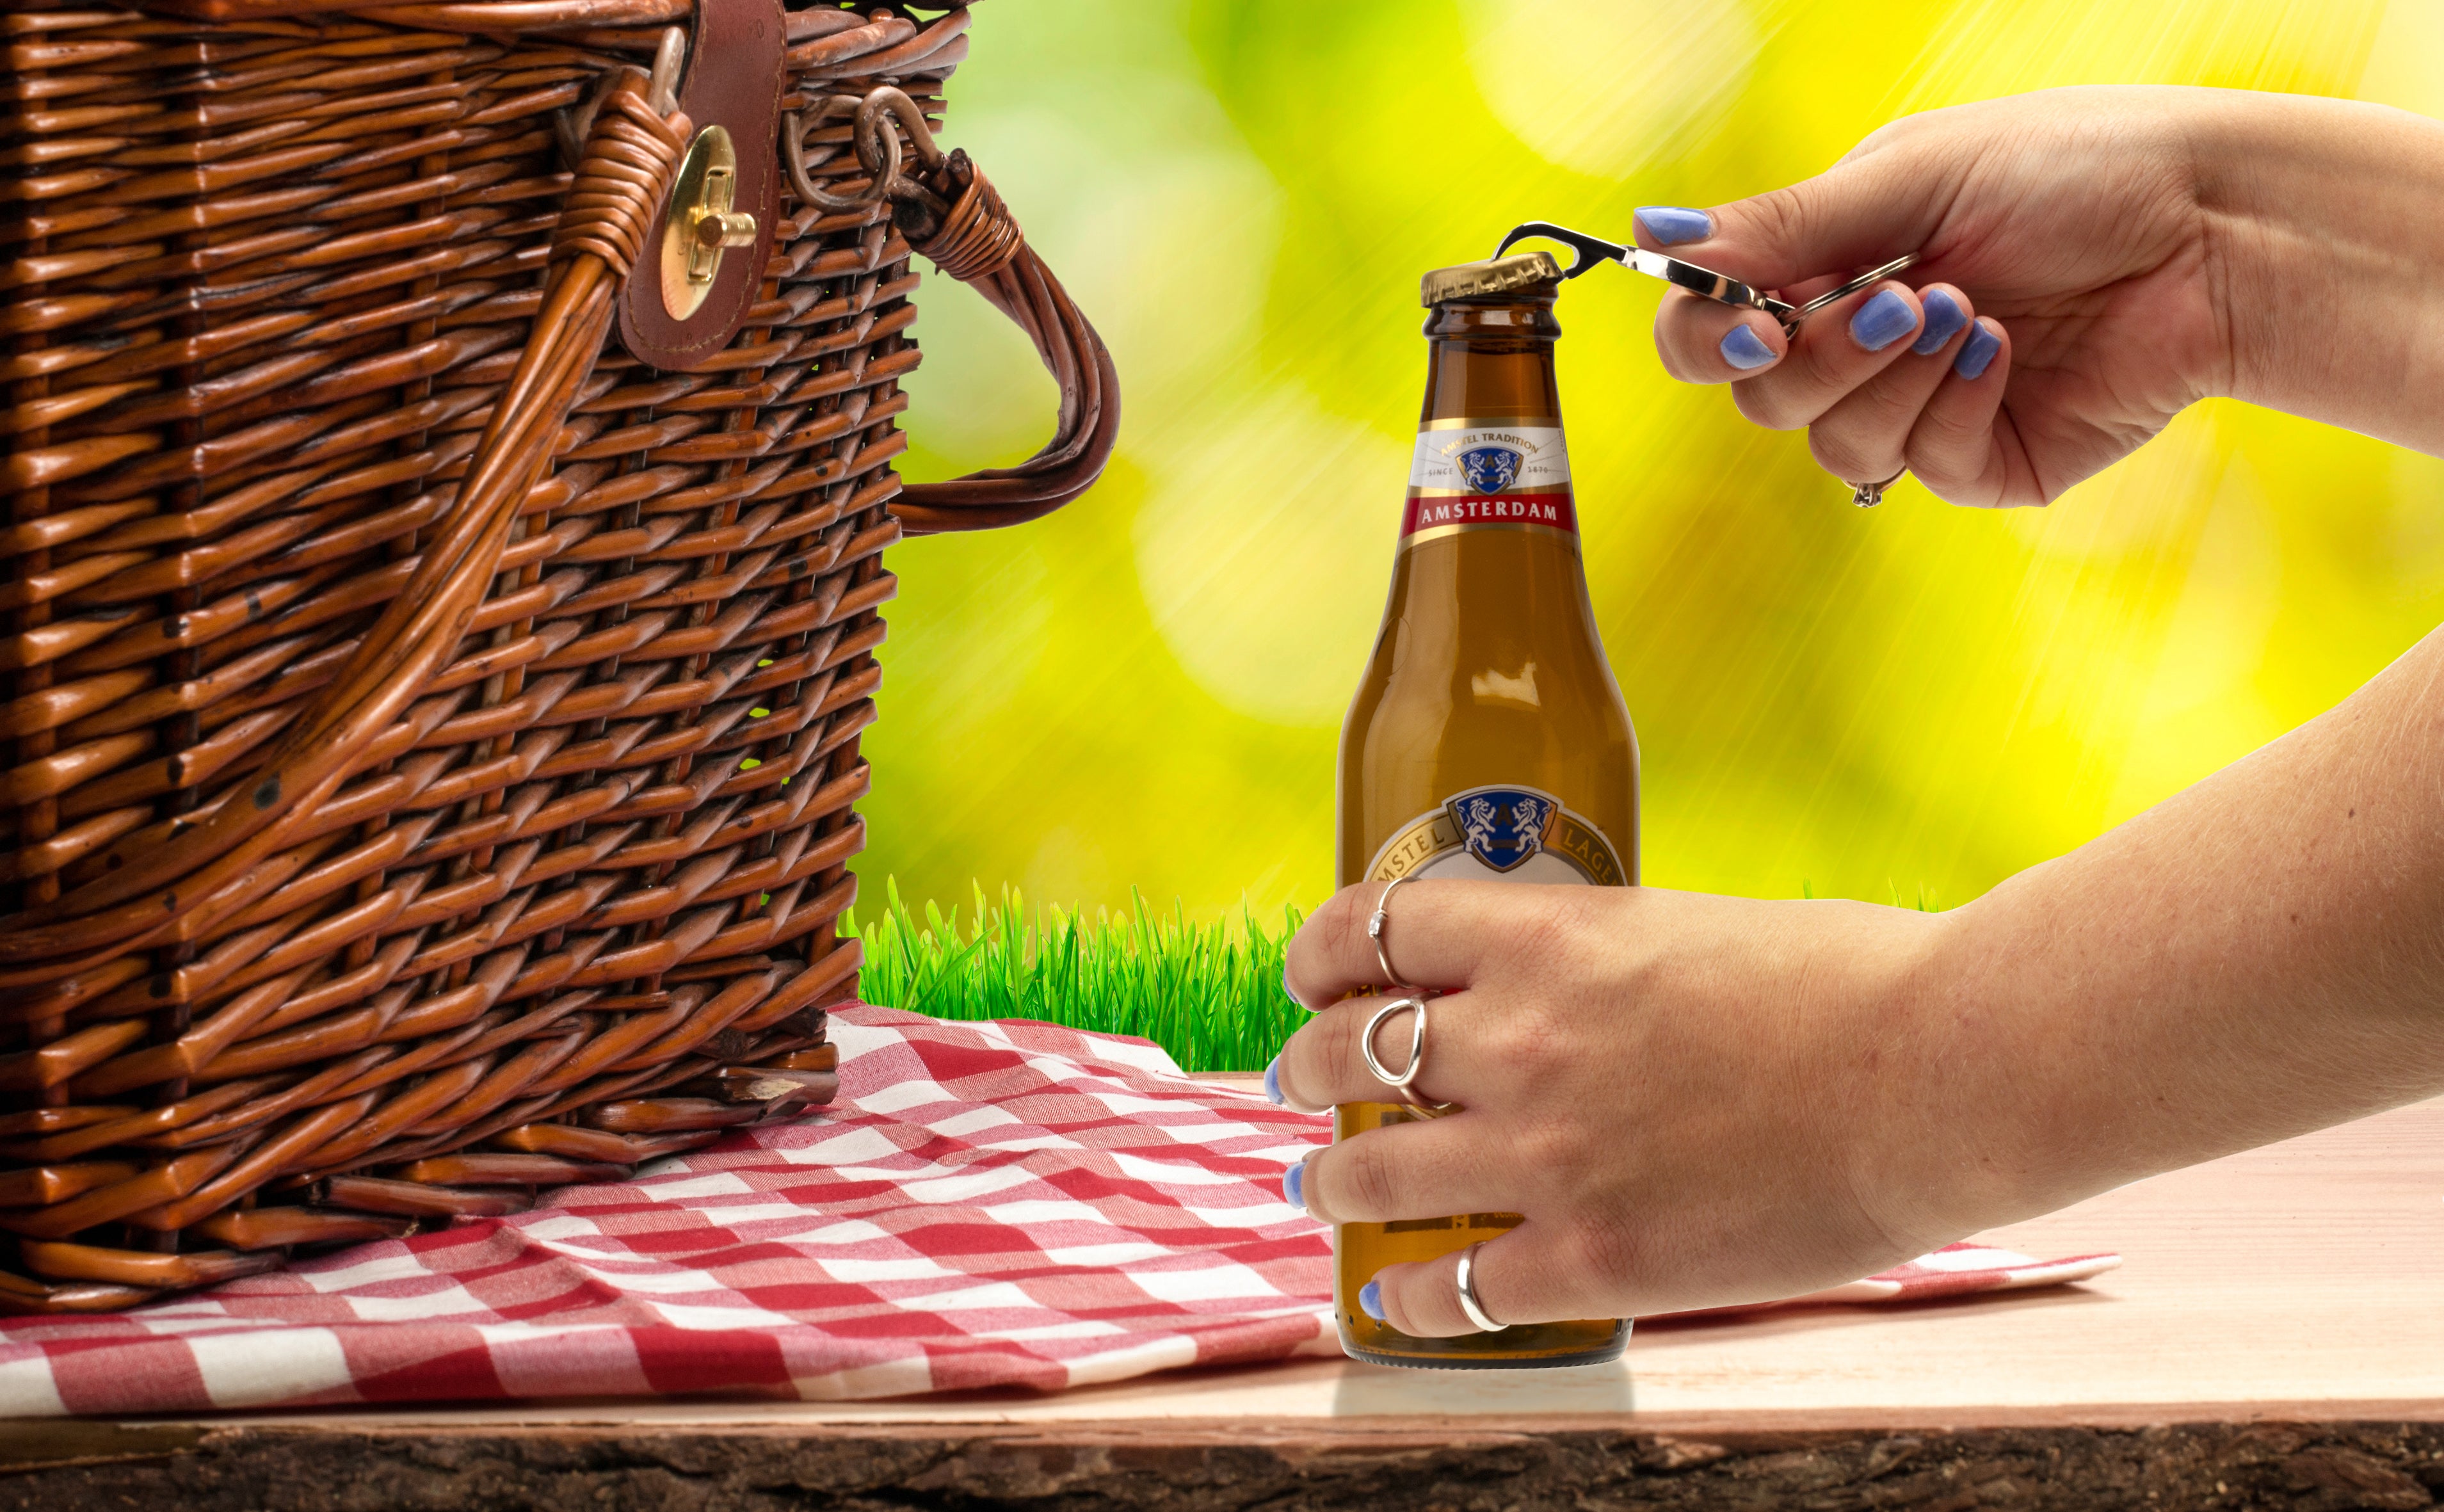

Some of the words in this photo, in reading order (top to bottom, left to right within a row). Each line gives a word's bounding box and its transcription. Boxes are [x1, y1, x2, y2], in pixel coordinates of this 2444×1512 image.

[1440, 435, 1478, 456] AMSTEL
[1481, 433, 1539, 454] TRADITION
[1429, 467, 1453, 476] SINCE
[1484, 454, 1496, 468] A
[1422, 501, 1557, 523] AMSTERDAM
[1495, 803, 1513, 826] A
[1378, 828, 1445, 881] MSTEL
